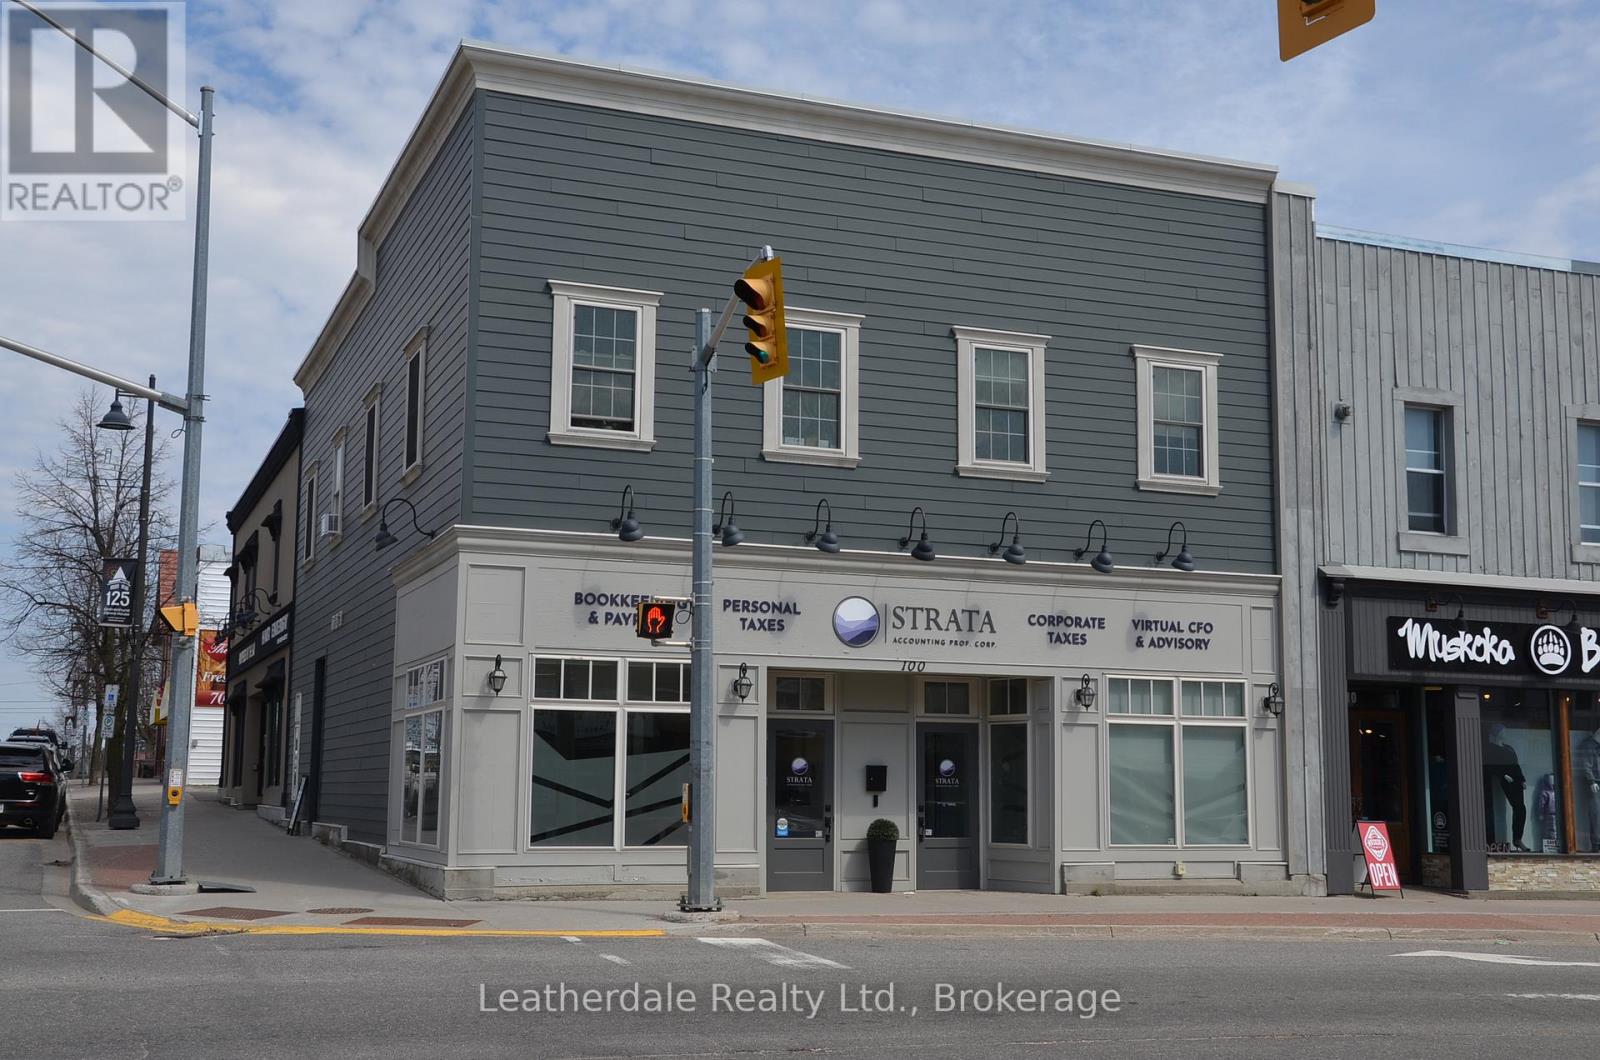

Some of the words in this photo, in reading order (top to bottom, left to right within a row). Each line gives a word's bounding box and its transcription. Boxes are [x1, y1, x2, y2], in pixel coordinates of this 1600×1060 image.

[106, 591, 130, 606] 125
[574, 592, 688, 609] BOOKKEEG
[722, 598, 802, 616] PERSONAL
[588, 610, 599, 625] &
[739, 617, 785, 632] TAXES
[892, 605, 997, 634] STRATA
[1027, 613, 1106, 631] CORPORATE
[1131, 618, 1185, 634] VIRTUAL
[1188, 621, 1214, 635] CFO
[892, 637, 946, 647] ACCOUNTING
[949, 639, 972, 648] PROF.
[974, 640, 998, 649] CORP.
[1047, 631, 1088, 646] TAXES
[1135, 635, 1145, 649] &
[1148, 636, 1211, 651] ADVISORY
[901, 660, 926, 673] 100
[786, 776, 813, 784] STRATA
[935, 777, 960, 785] STRATA
[1369, 862, 1400, 887] OPEN
